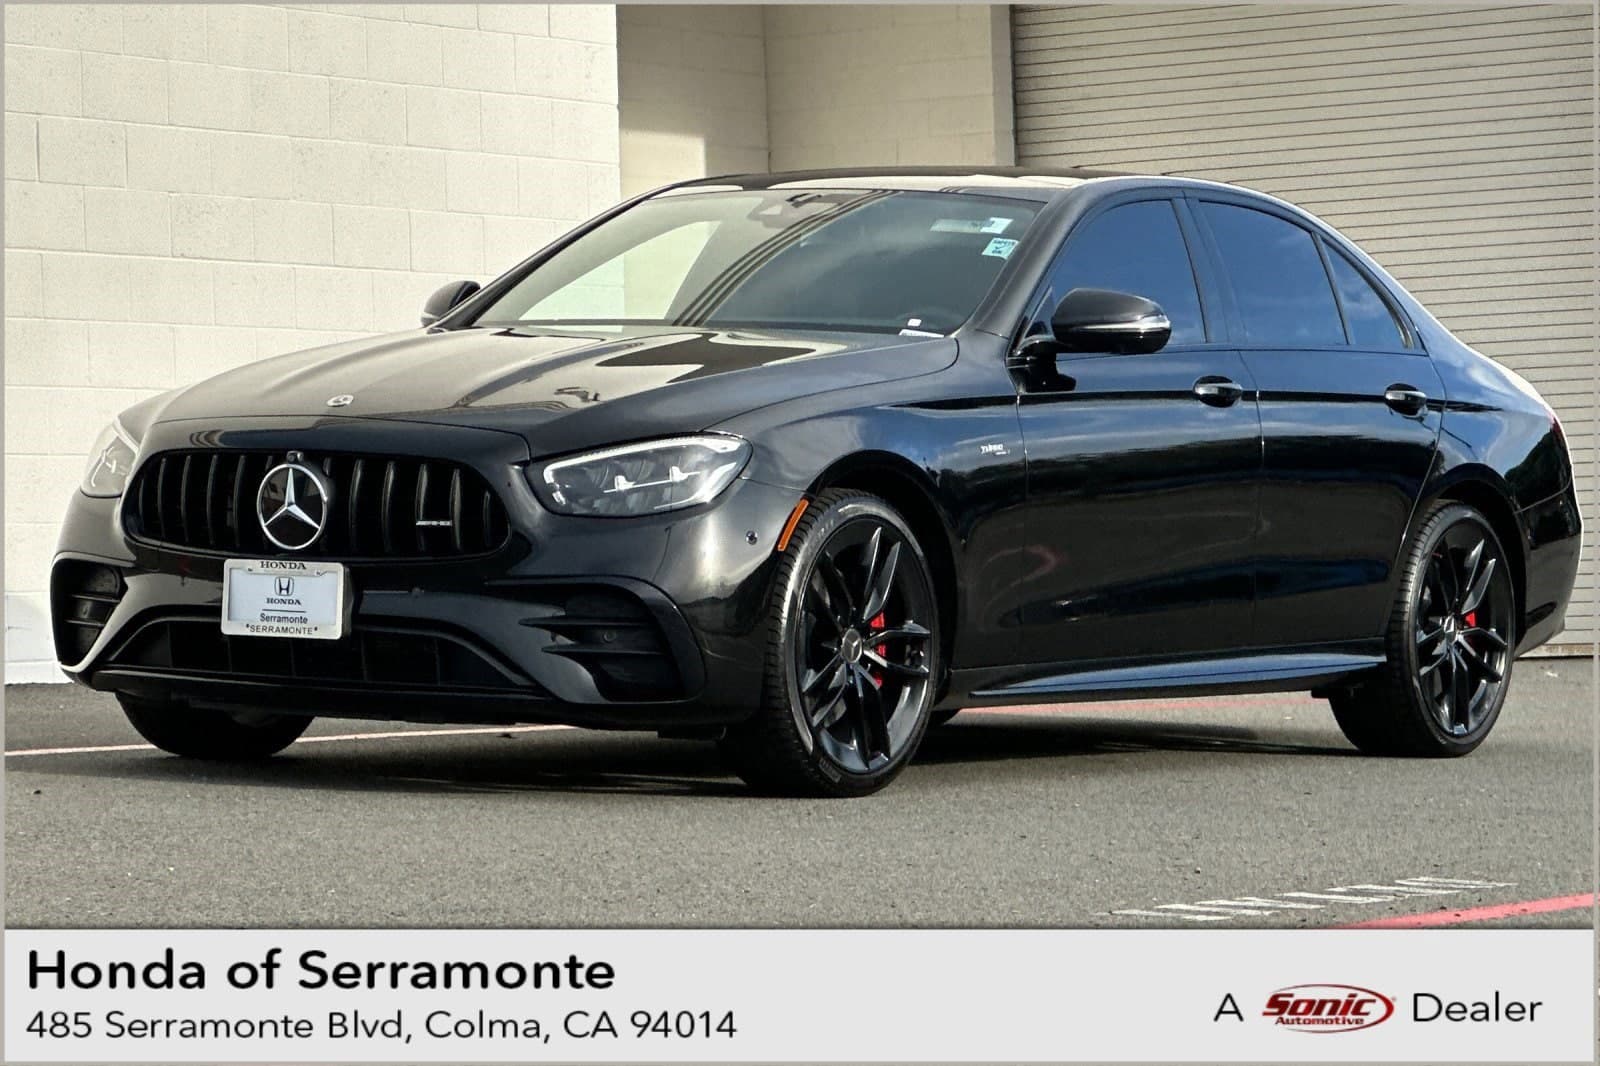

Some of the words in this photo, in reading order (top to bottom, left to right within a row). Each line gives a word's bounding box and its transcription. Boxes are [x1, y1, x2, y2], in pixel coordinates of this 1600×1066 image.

[260, 560, 307, 570] HONDA
[266, 597, 302, 605] HONDA
[260, 612, 308, 624] Serramonte
